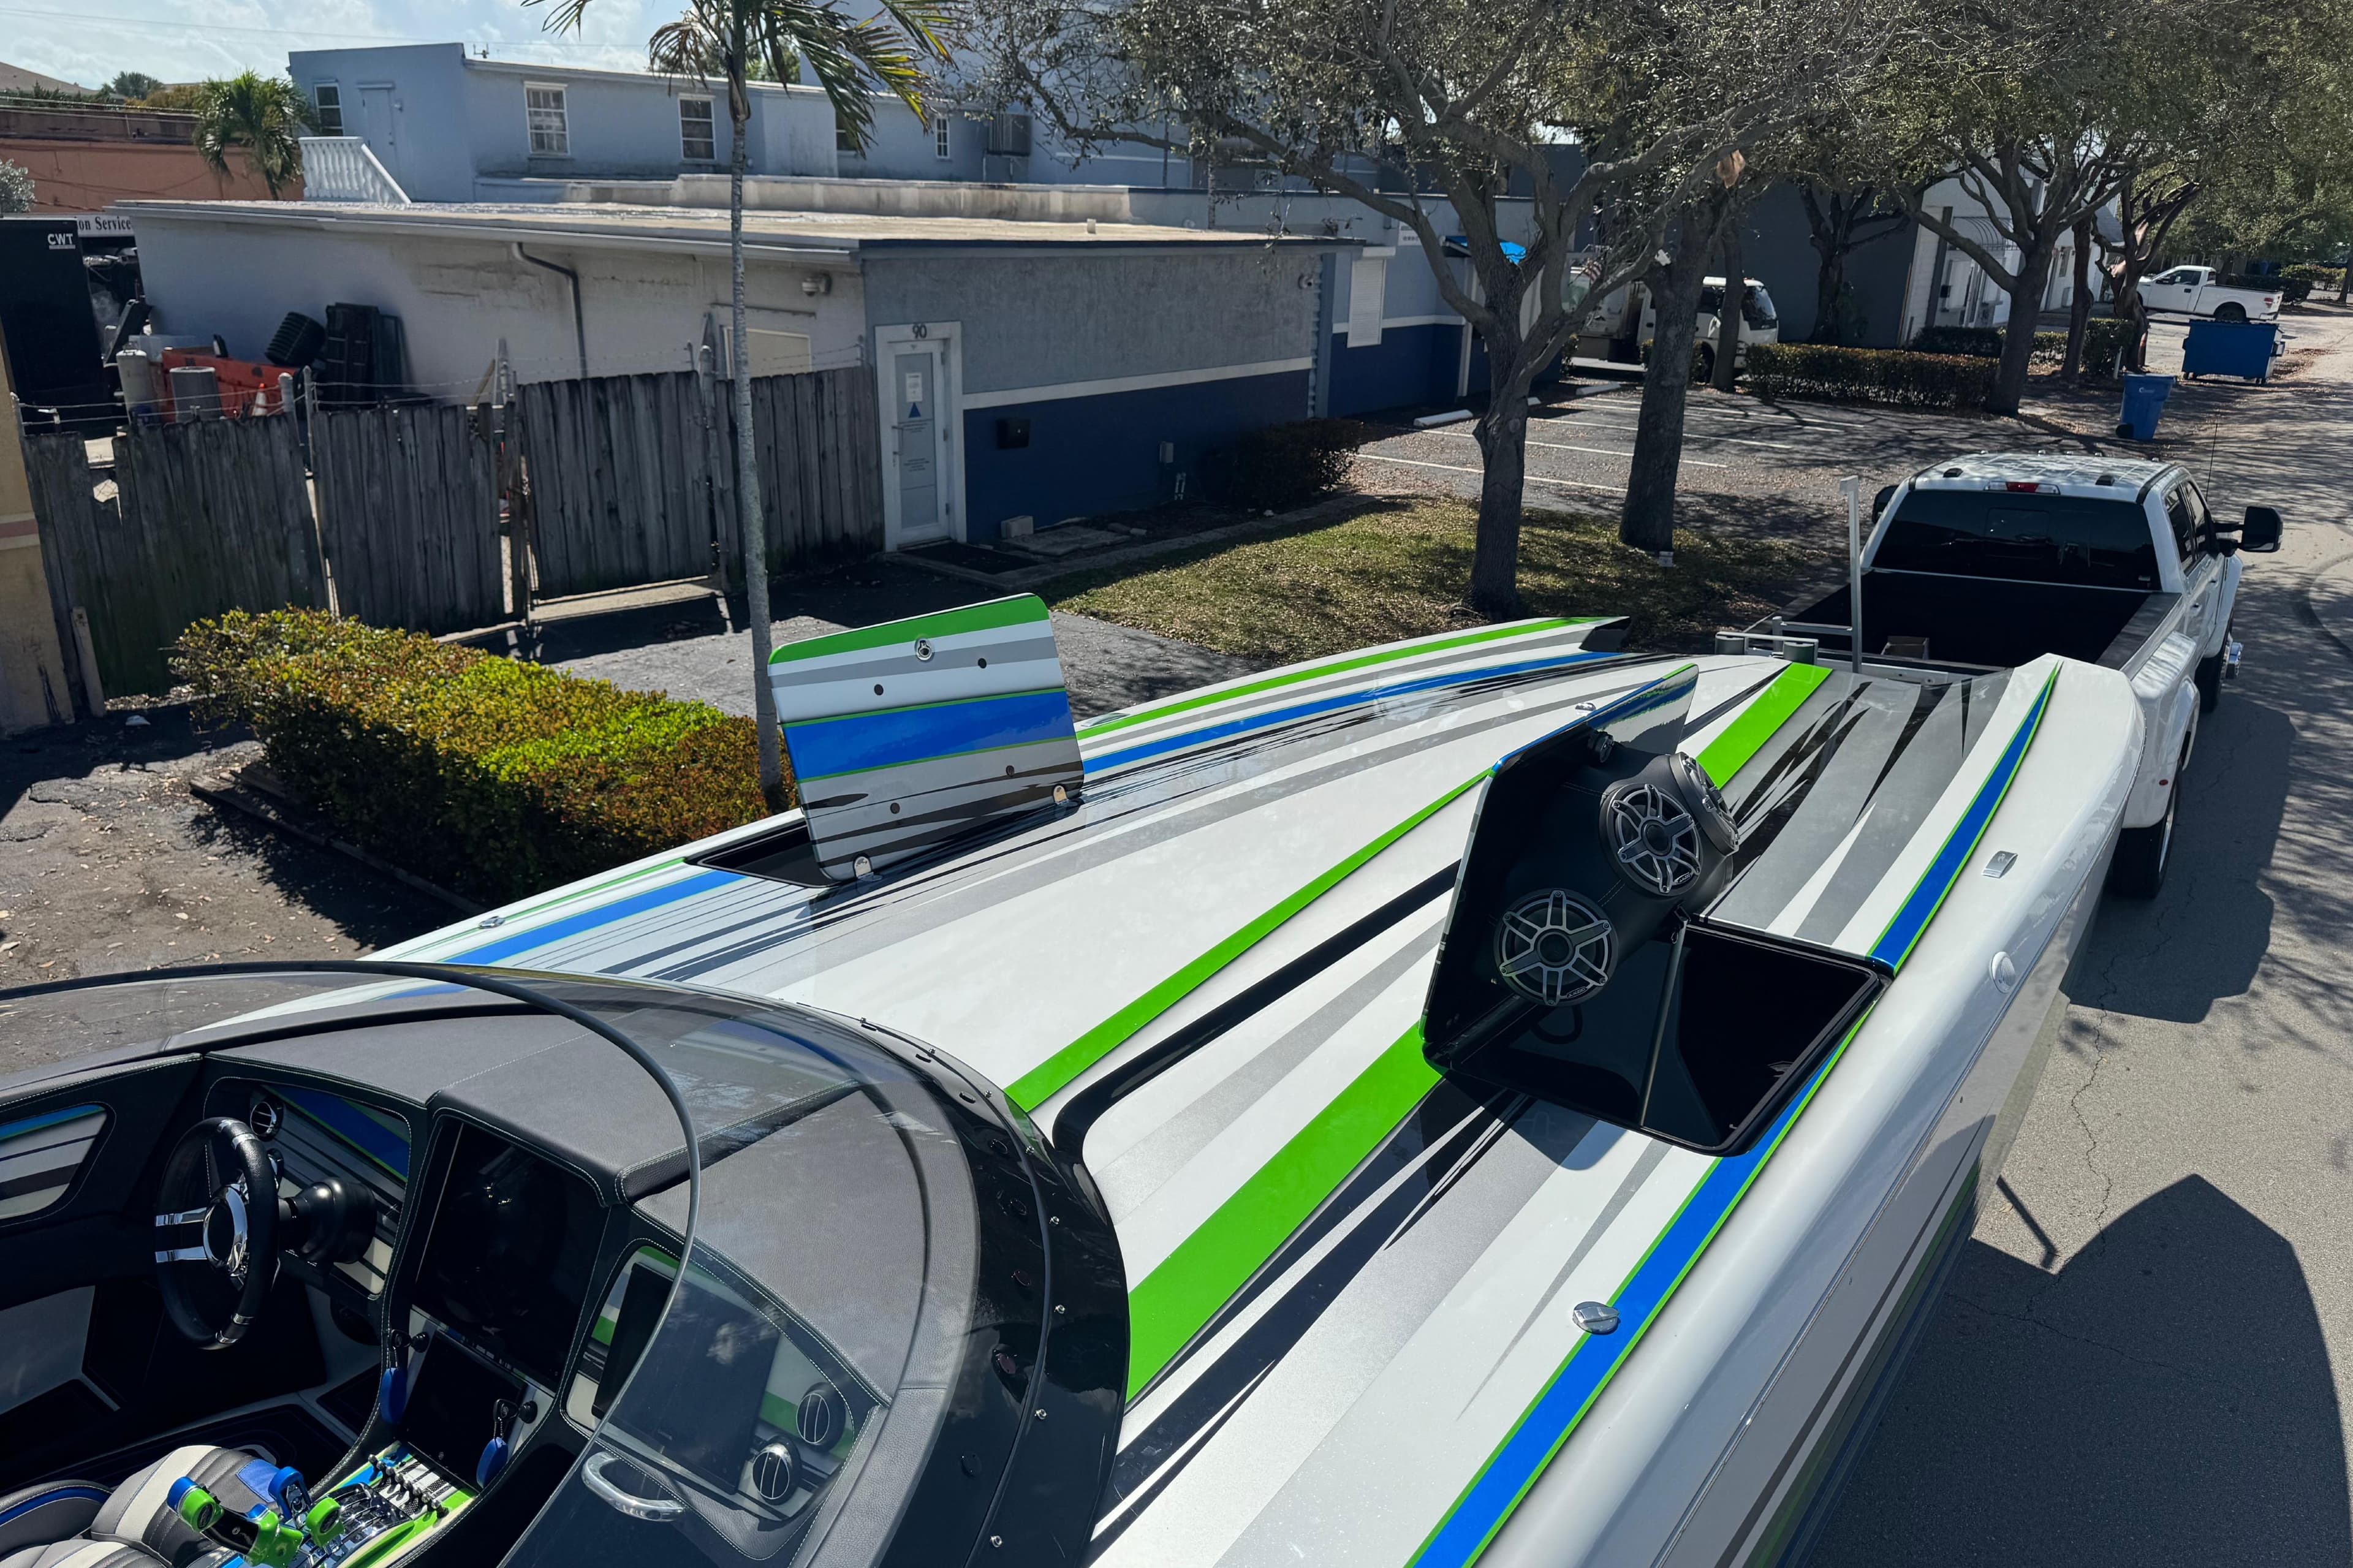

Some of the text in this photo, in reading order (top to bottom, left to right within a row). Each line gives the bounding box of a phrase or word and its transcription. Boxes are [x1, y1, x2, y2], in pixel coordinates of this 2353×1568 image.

[95, 216, 131, 230] Service
[48, 233, 73, 245] CWT
[912, 324, 926, 339] 90
